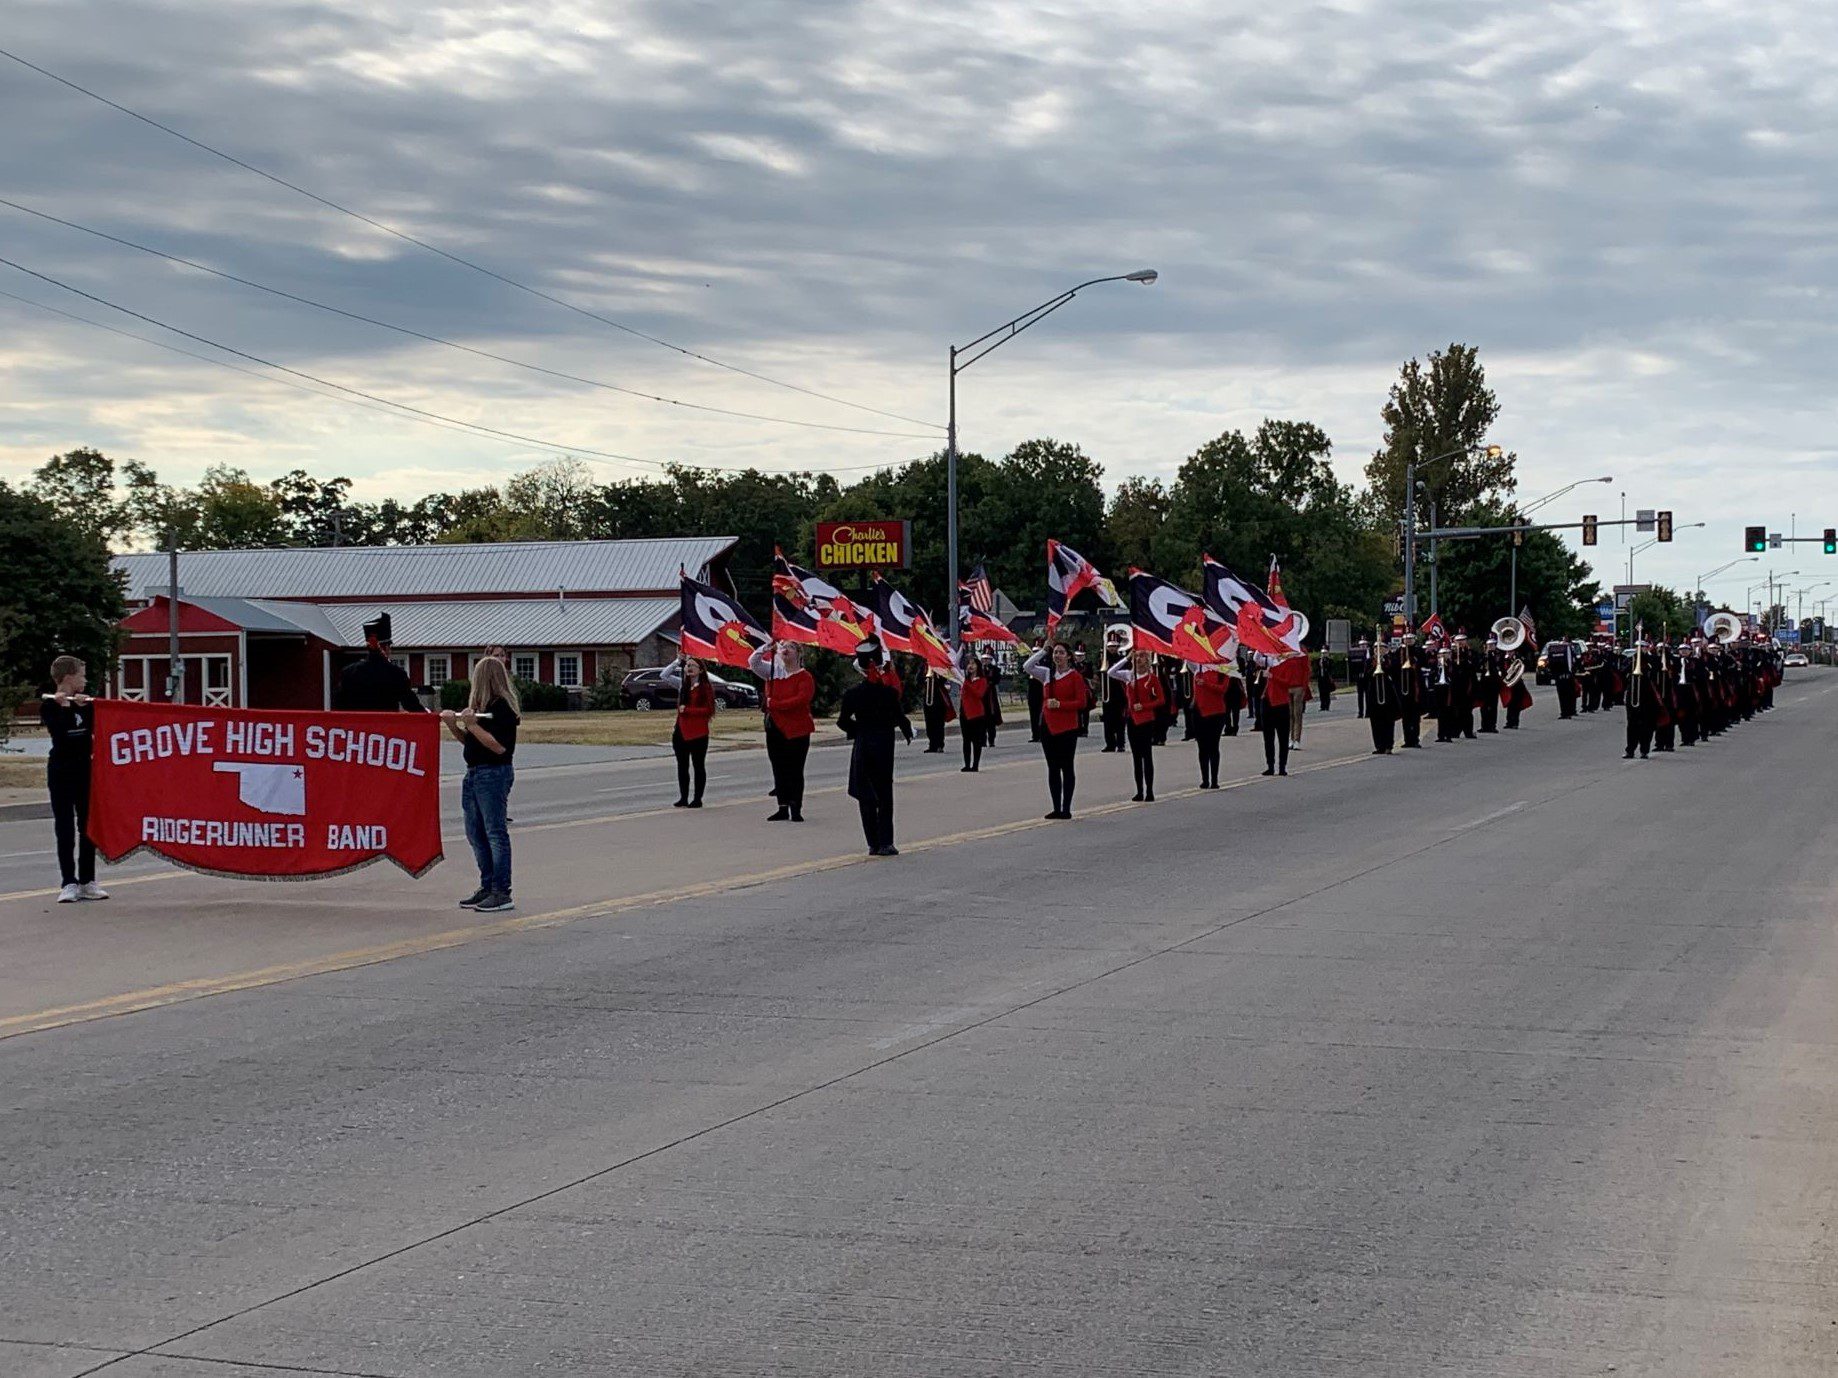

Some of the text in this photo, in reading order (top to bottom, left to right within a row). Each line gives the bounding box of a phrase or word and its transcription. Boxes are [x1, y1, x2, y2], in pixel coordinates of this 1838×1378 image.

[832, 525, 886, 546] Charlie's
[820, 542, 899, 565] CHICKEN
[110, 720, 425, 776] GROVE HIGH SCHOOL
[141, 816, 387, 850] RIDGERUNNER BAND
